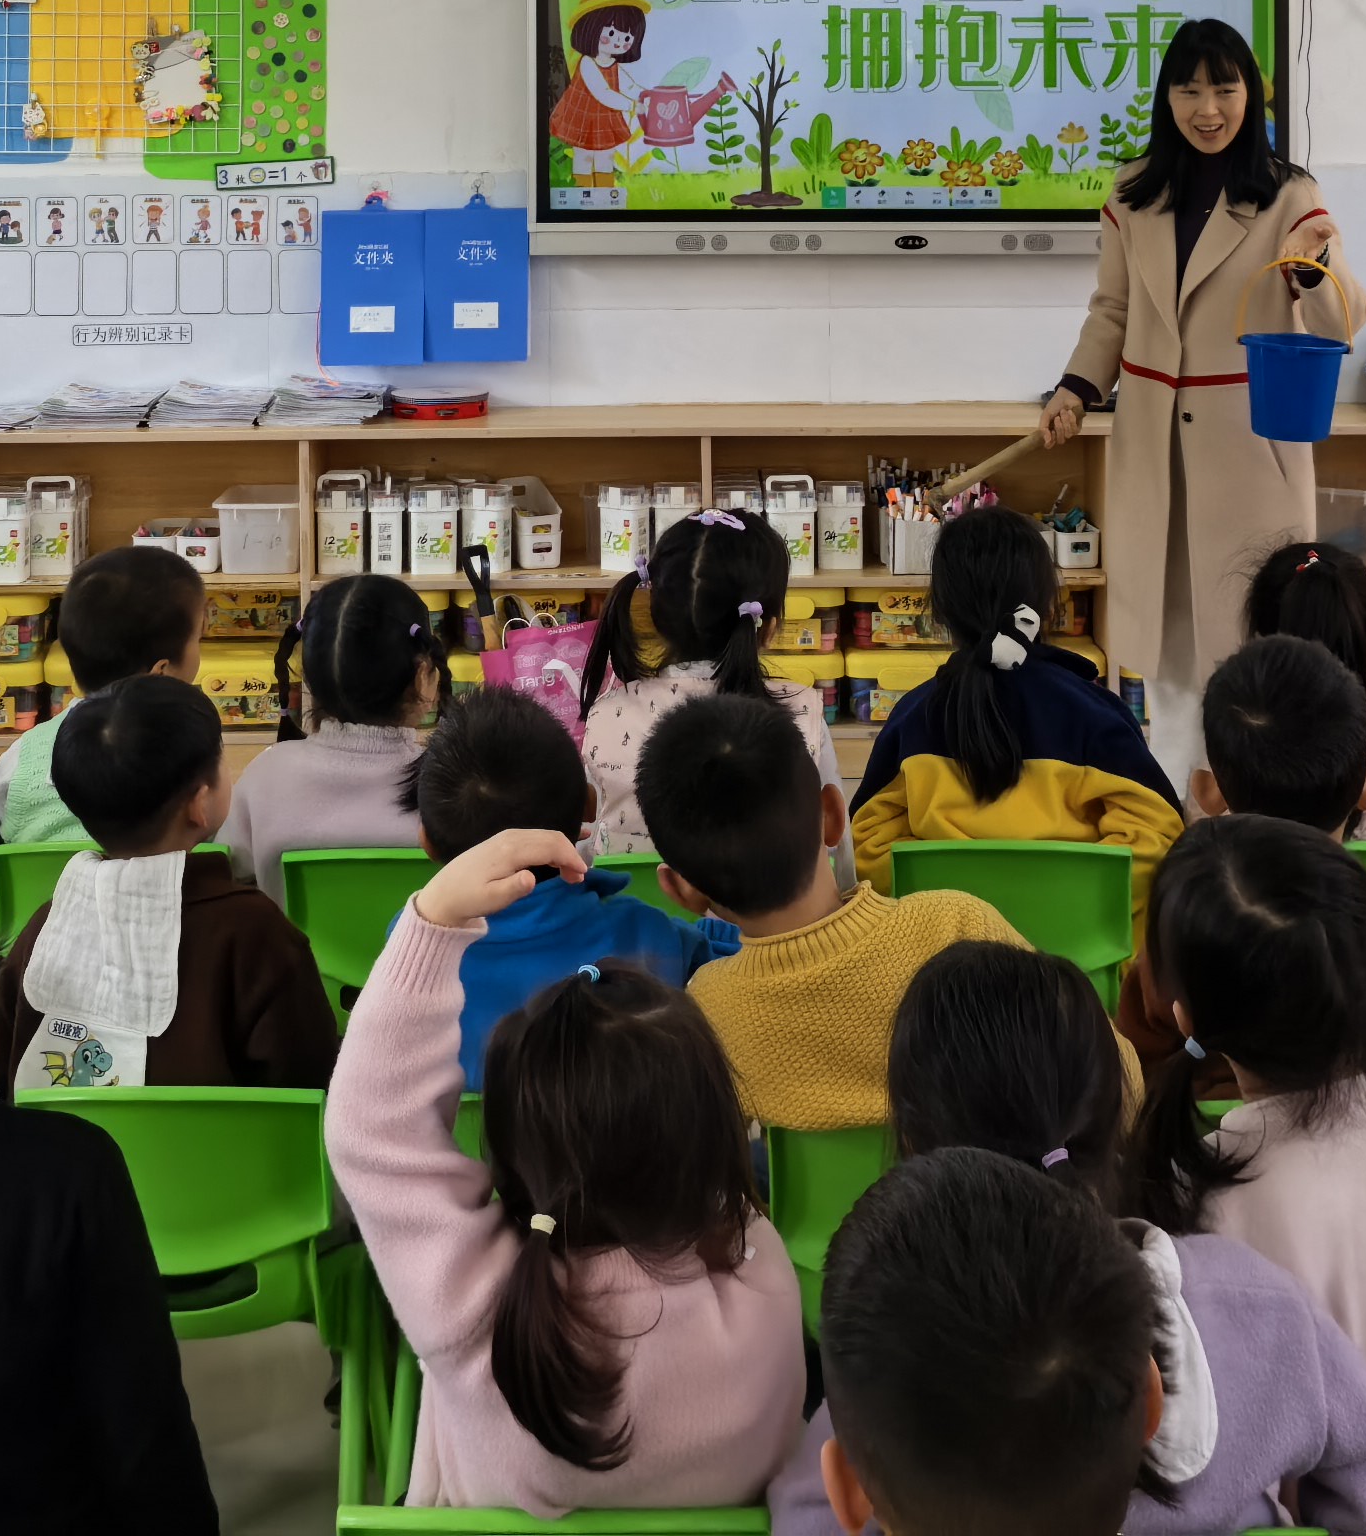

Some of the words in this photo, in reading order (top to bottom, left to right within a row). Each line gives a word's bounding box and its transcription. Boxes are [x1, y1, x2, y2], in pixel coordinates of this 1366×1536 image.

[821, 5, 1188, 94] 拥抱未来
[219, 169, 229, 185] 3
[296, 171, 308, 182] 个
[353, 251, 394, 265] 文件夹
[457, 246, 497, 262] 文件夹
[75, 326, 190, 344] 行为辨别记录卡
[324, 536, 336, 545] 12
[417, 533, 429, 545] 16
[824, 530, 838, 542] 24
[610, 763, 622, 771] you
